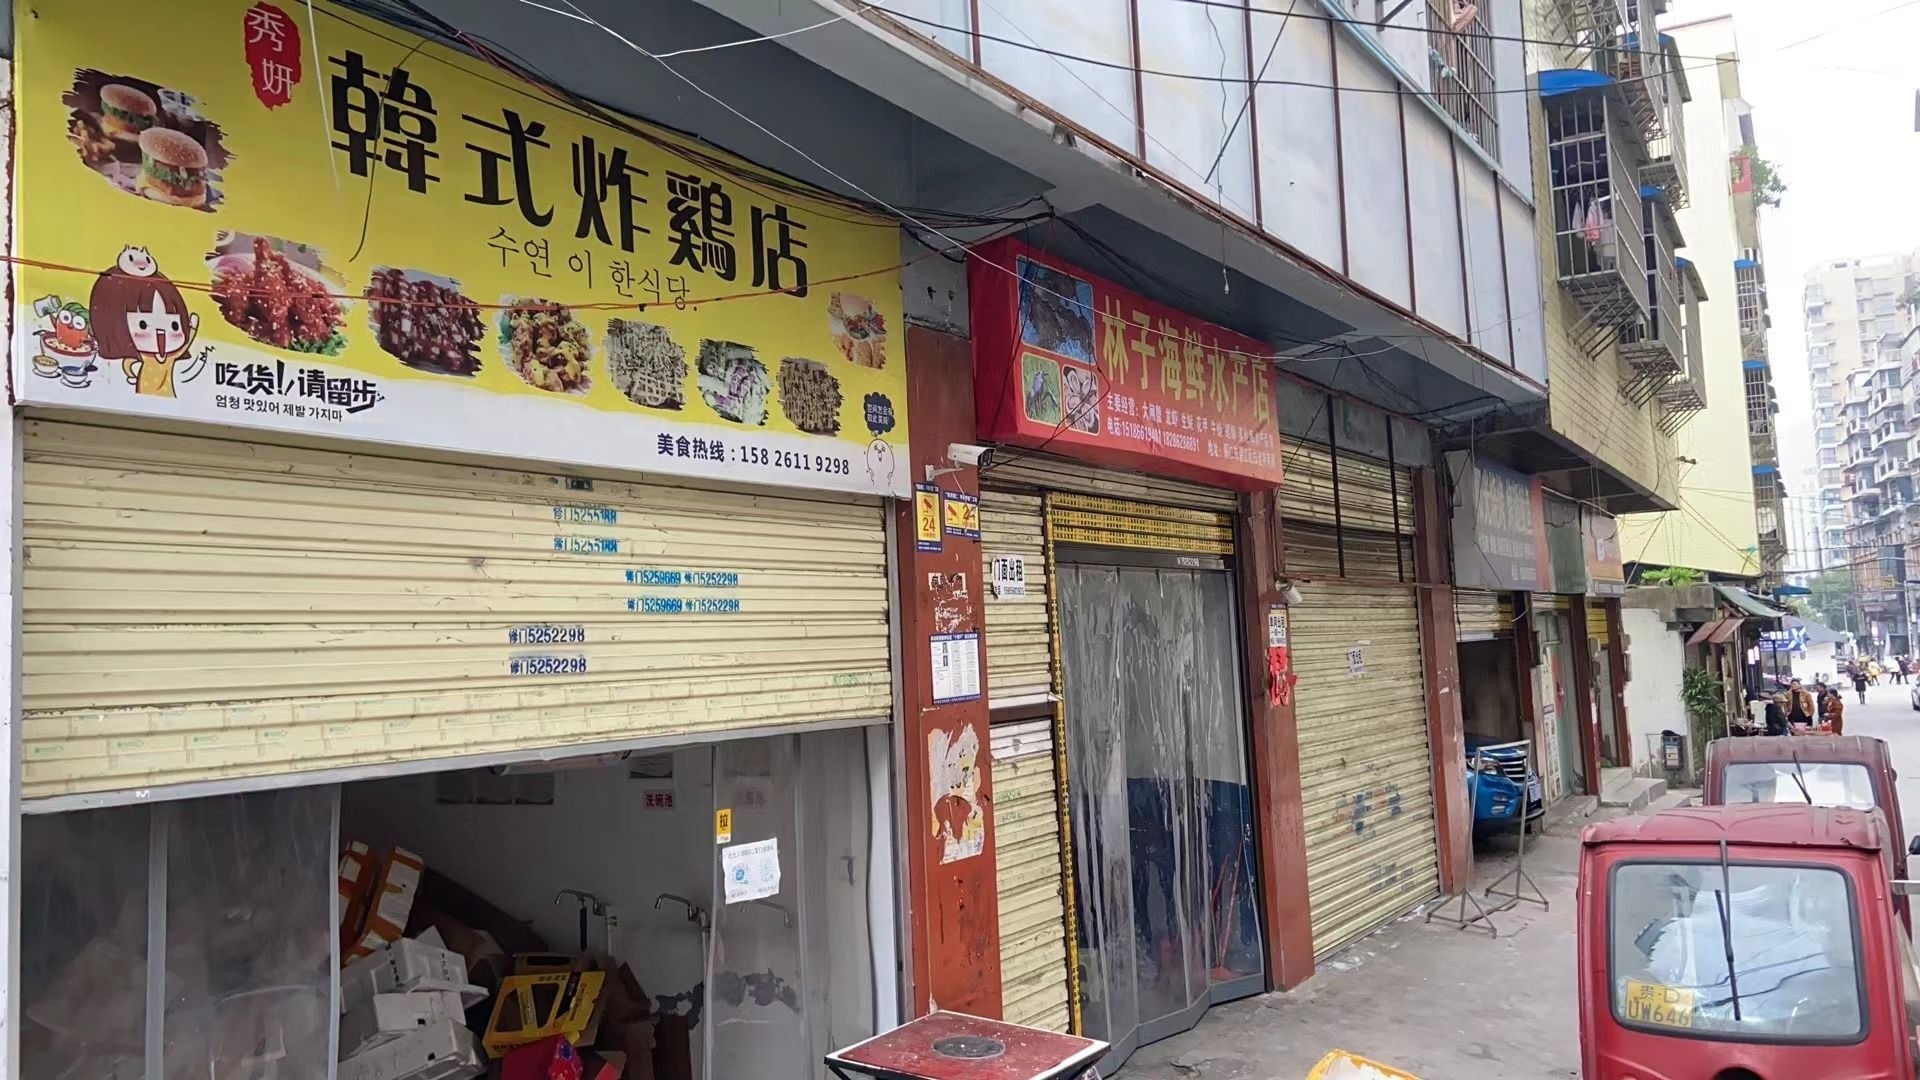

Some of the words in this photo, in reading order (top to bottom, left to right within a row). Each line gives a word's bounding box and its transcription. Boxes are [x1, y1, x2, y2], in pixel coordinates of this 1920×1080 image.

[248, 8, 294, 97] 秀妍
[487, 226, 552, 278] 수연
[569, 250, 592, 289] 이
[1102, 295, 1271, 425] 林子海鲜水产店
[215, 394, 240, 409] 엄청
[244, 398, 280, 414] 맛있어
[283, 403, 306, 418] 제발
[309, 406, 343, 422] 가지마
[922, 516, 936, 532] 24
[994, 558, 1023, 581] 门面出租
[719, 813, 729, 828] 拉
